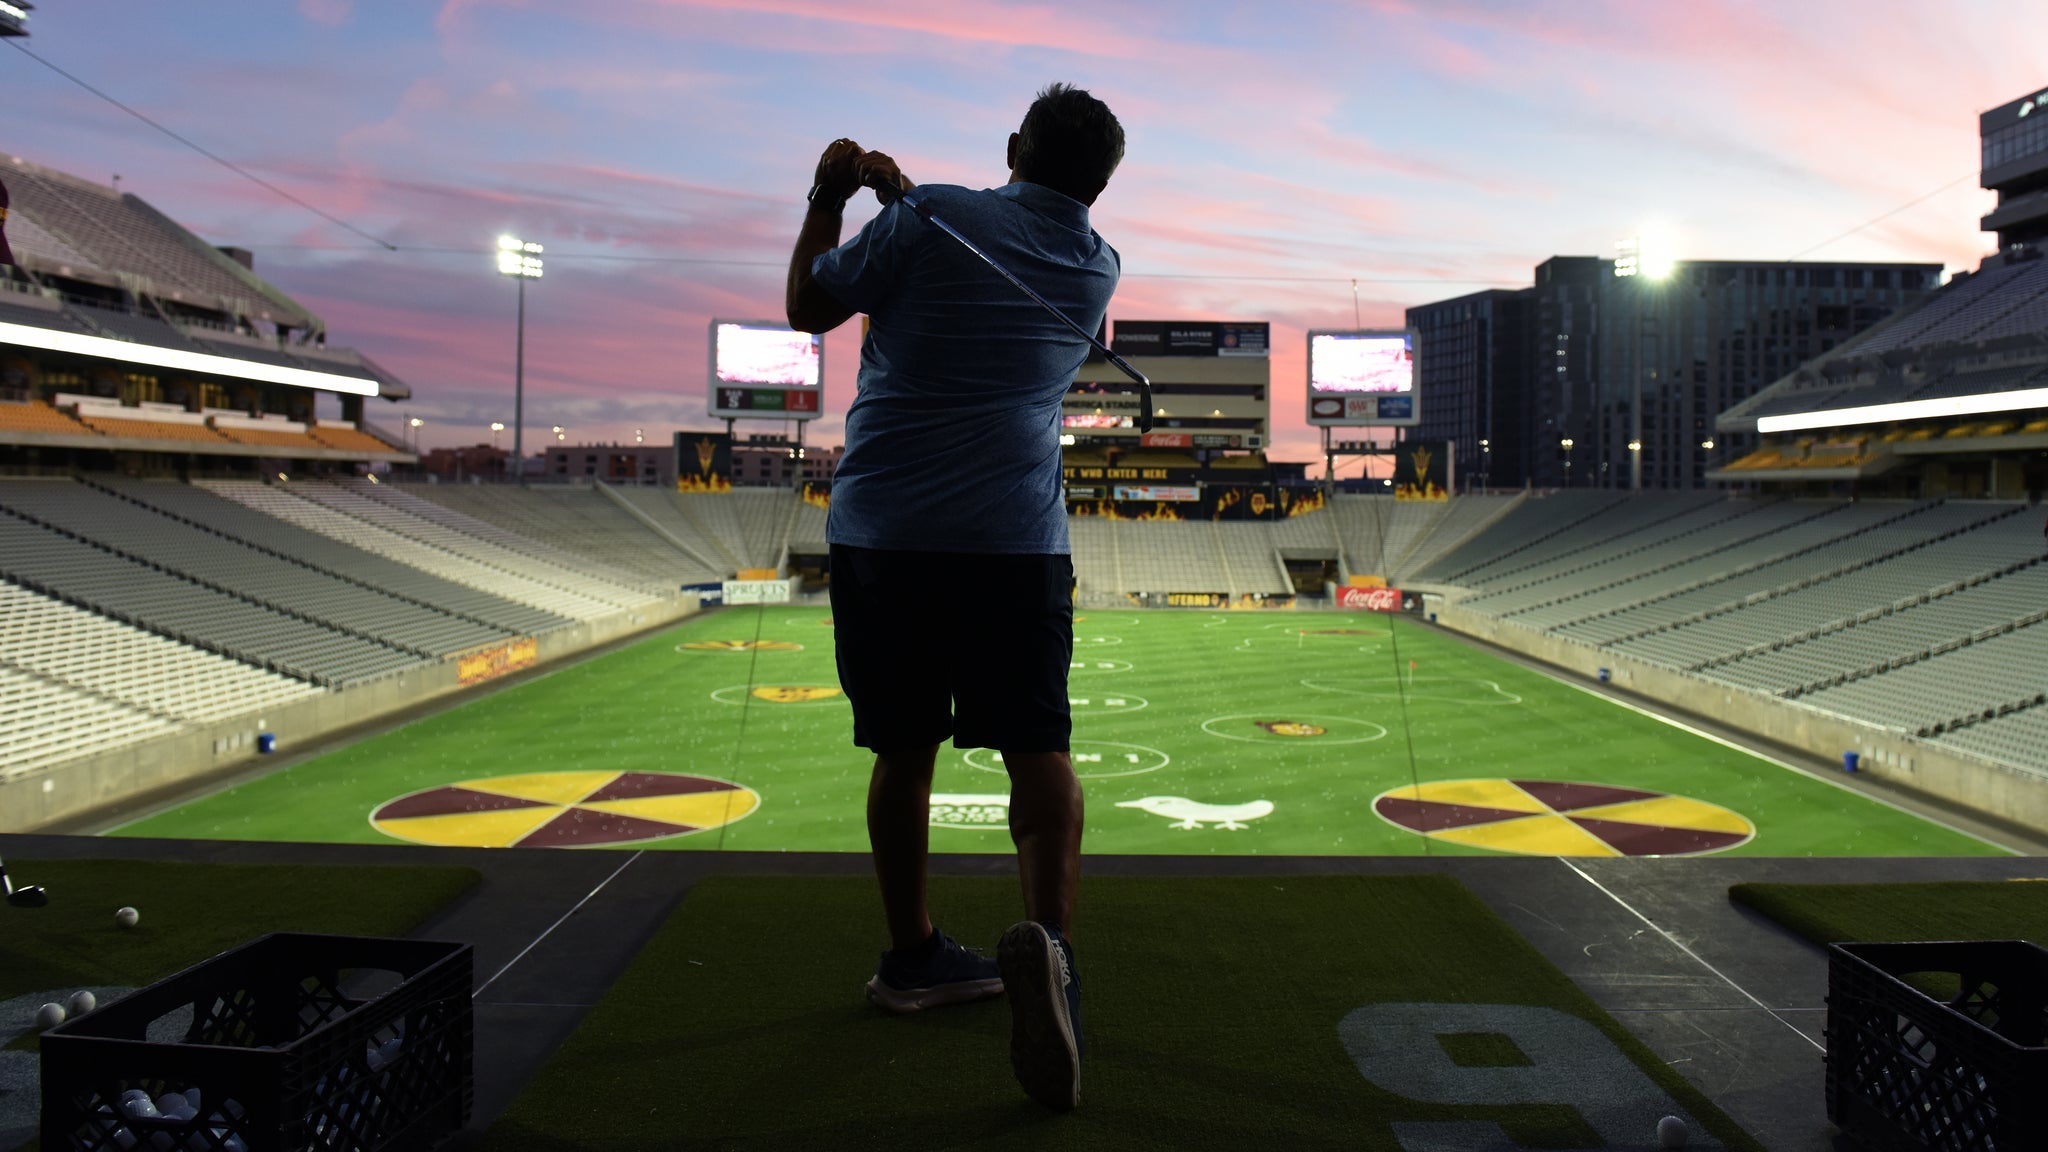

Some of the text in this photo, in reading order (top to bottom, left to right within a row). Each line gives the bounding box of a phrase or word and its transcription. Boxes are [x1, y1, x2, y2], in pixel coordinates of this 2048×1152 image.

[1080, 469, 1103, 478] WHO
[1107, 469, 1138, 479] ENTER
[1142, 469, 1168, 479] HERE
[1050, 939, 1072, 986] HOKA
